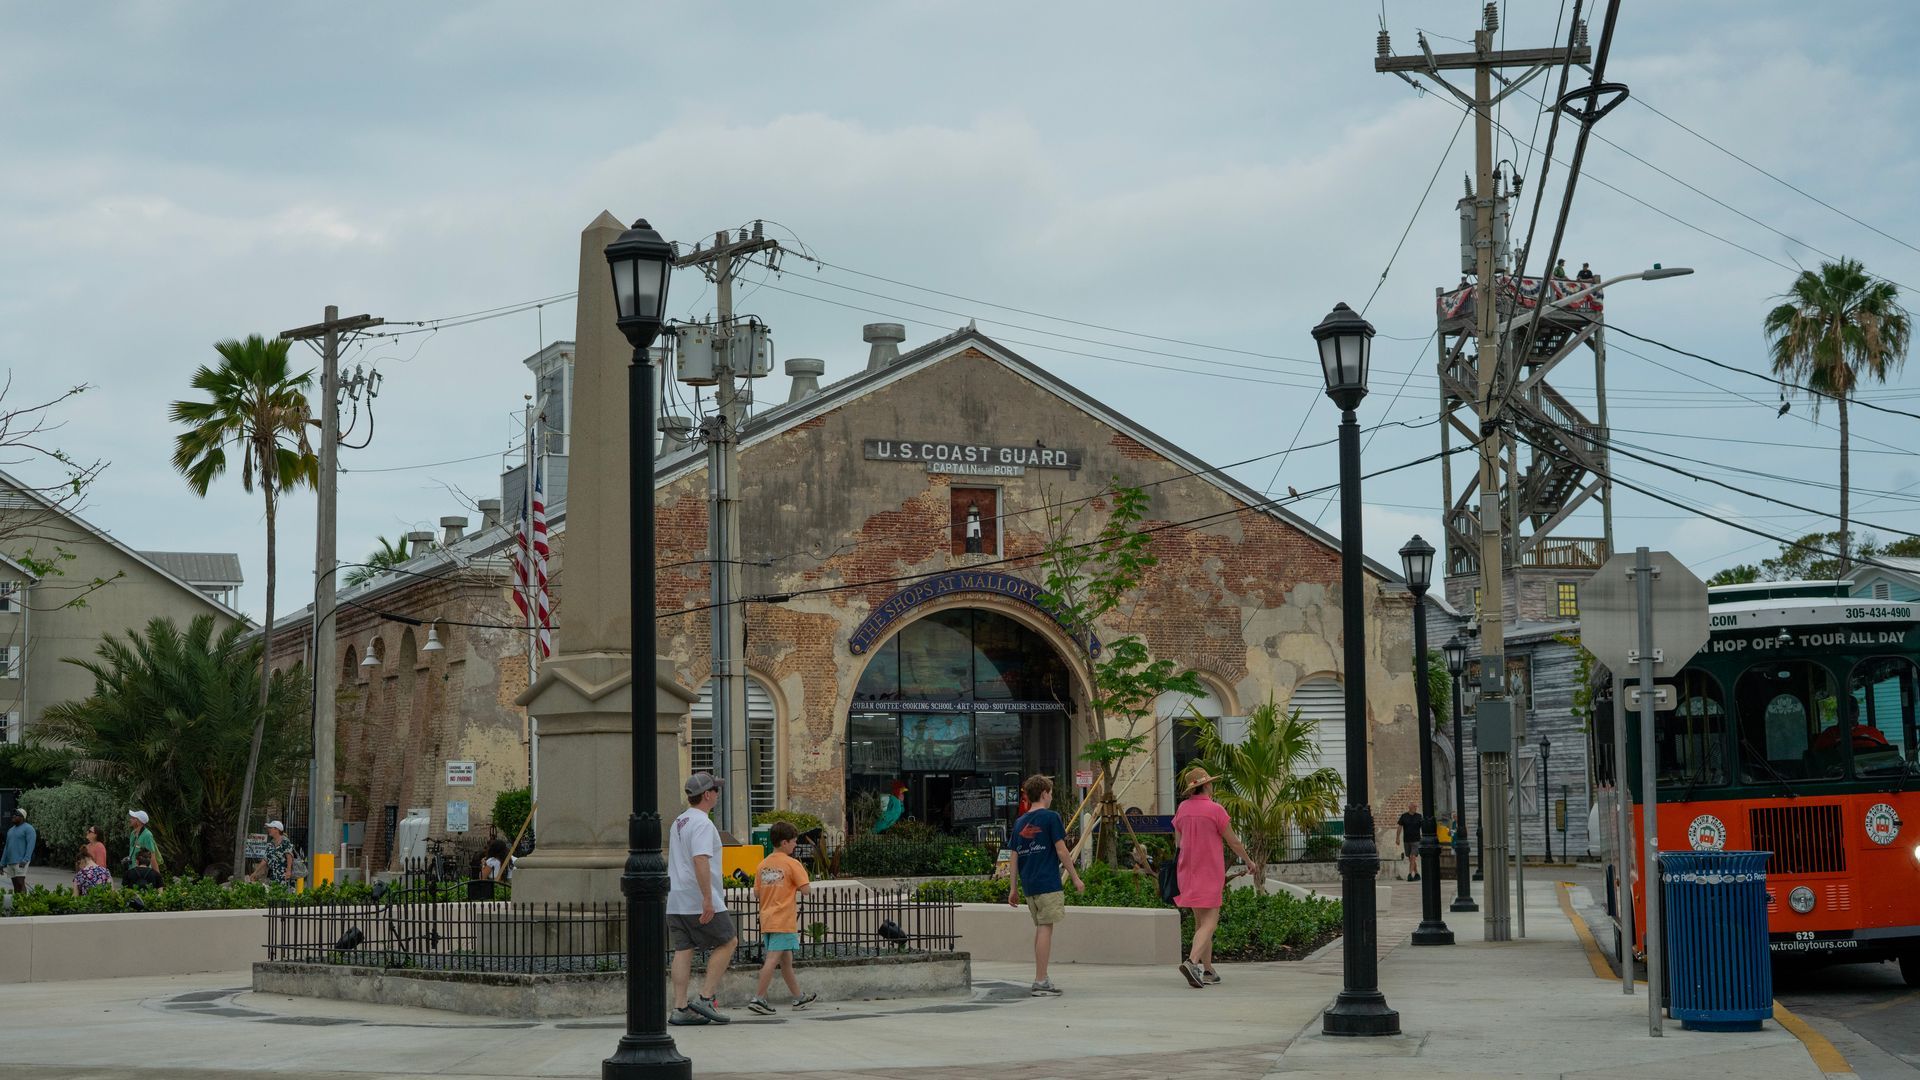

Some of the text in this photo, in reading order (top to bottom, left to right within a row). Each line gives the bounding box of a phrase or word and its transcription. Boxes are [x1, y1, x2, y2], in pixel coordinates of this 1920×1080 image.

[1000, 448, 1068, 466] GUARD
[933, 462, 977, 474] CAPTAIN
[994, 465, 1018, 475] PORT
[857, 575, 1038, 645] THE SHOPS AT MALLORY
[1845, 608, 1911, 619] 305-434-4900
[1713, 639, 1747, 652] HOP
[1752, 636, 1784, 650] OFF
[1799, 632, 1846, 647] TOUR
[1849, 632, 1876, 645] ALL
[1878, 631, 1906, 644] DAY
[852, 702, 874, 710] CUBAN
[875, 702, 900, 710] COFFEE
[902, 702, 930, 710] COOKING
[930, 702, 954, 710] SCHOOL
[957, 702, 970, 710] ART
[974, 702, 989, 710] FOOD
[992, 702, 1027, 710] SOUVENIRS
[1129, 816, 1159, 825] SHOPS
[1795, 931, 1815, 940] 629
[1770, 940, 1858, 951] w.trolleytours.com
